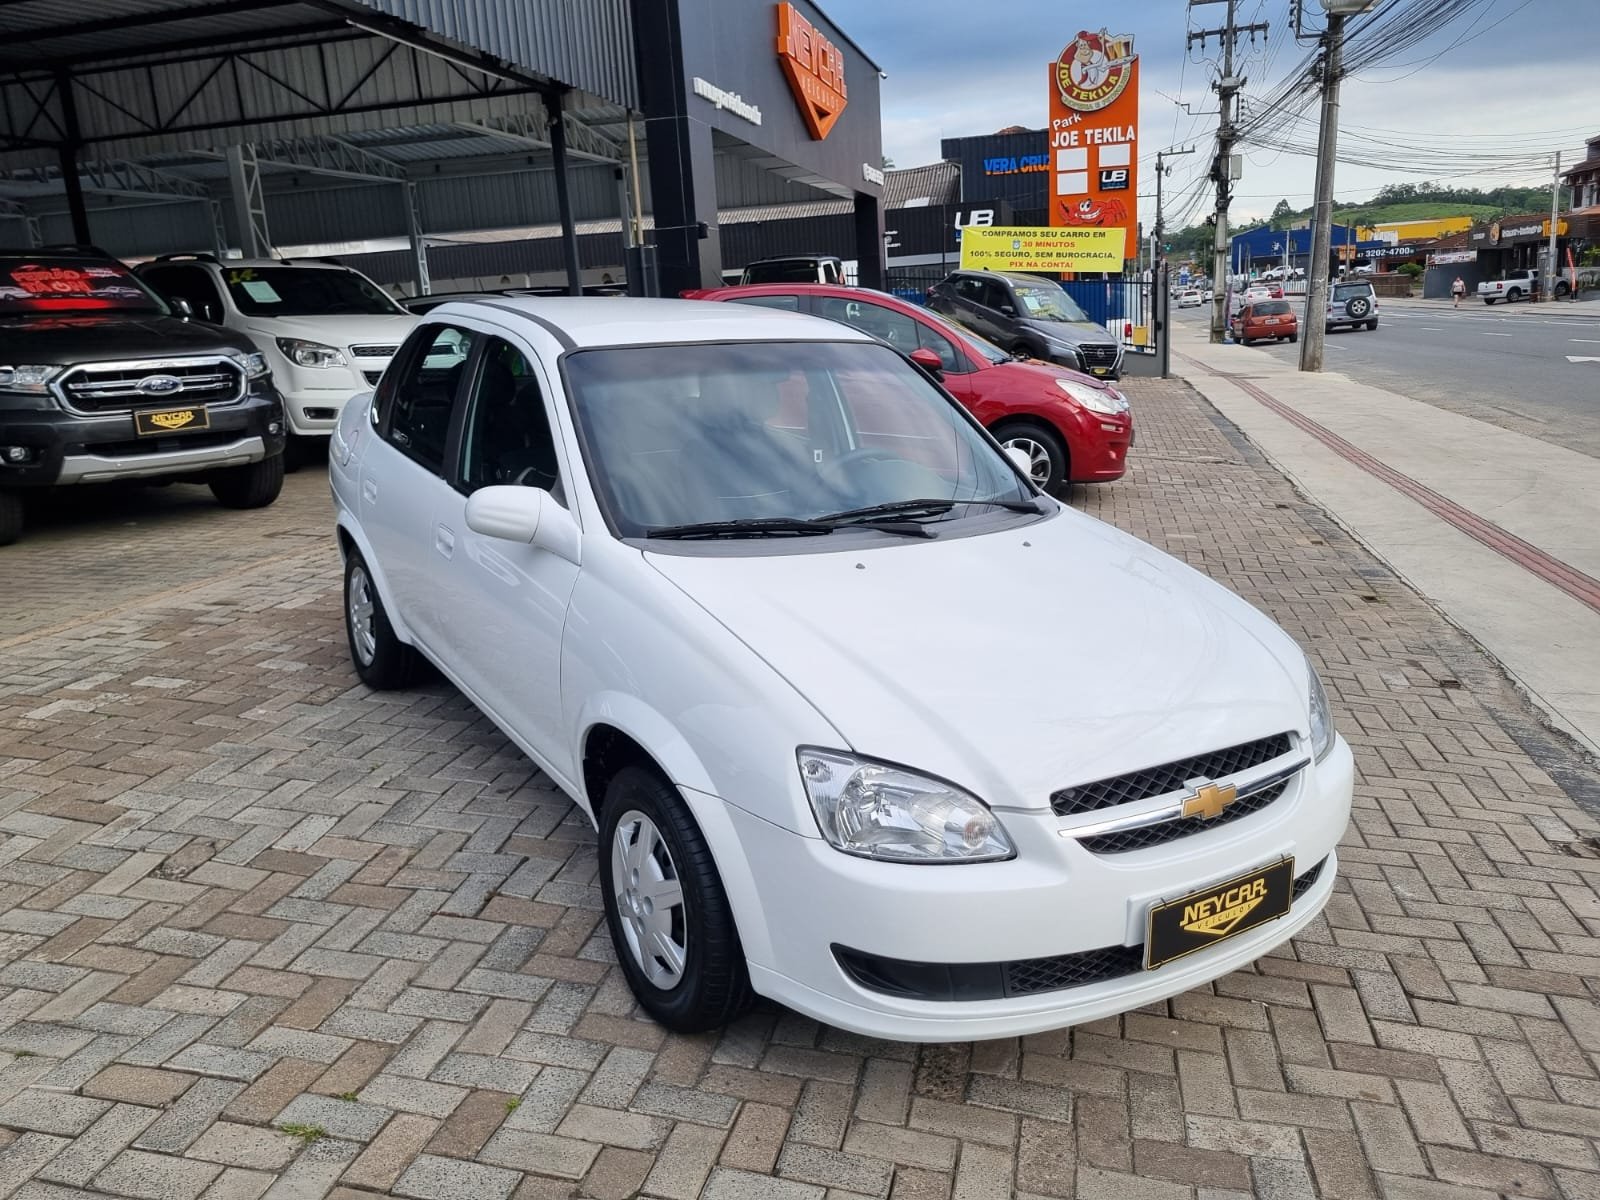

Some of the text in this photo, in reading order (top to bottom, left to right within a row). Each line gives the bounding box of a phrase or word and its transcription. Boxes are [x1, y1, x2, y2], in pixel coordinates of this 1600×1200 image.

[1060, 61, 1071, 89] JOE
[1071, 75, 1119, 101] TEKILA
[1052, 112, 1082, 131] Park
[1051, 125, 1136, 147] JOE TEKILA
[983, 157, 1018, 174] VERA
[1101, 170, 1127, 183] UB
[954, 209, 995, 230] UB
[982, 230, 1037, 238] COMPRAMOS
[1059, 231, 1090, 239] CARRO
[1092, 231, 1106, 239] EM
[1035, 241, 1076, 249] MINUTOS
[1365, 247, 1410, 257] 3202-4700
[994, 251, 1033, 259] SEGURO,
[1055, 251, 1116, 260] BUROCRACIA,
[1179, 878, 1268, 927] NEYCAR
